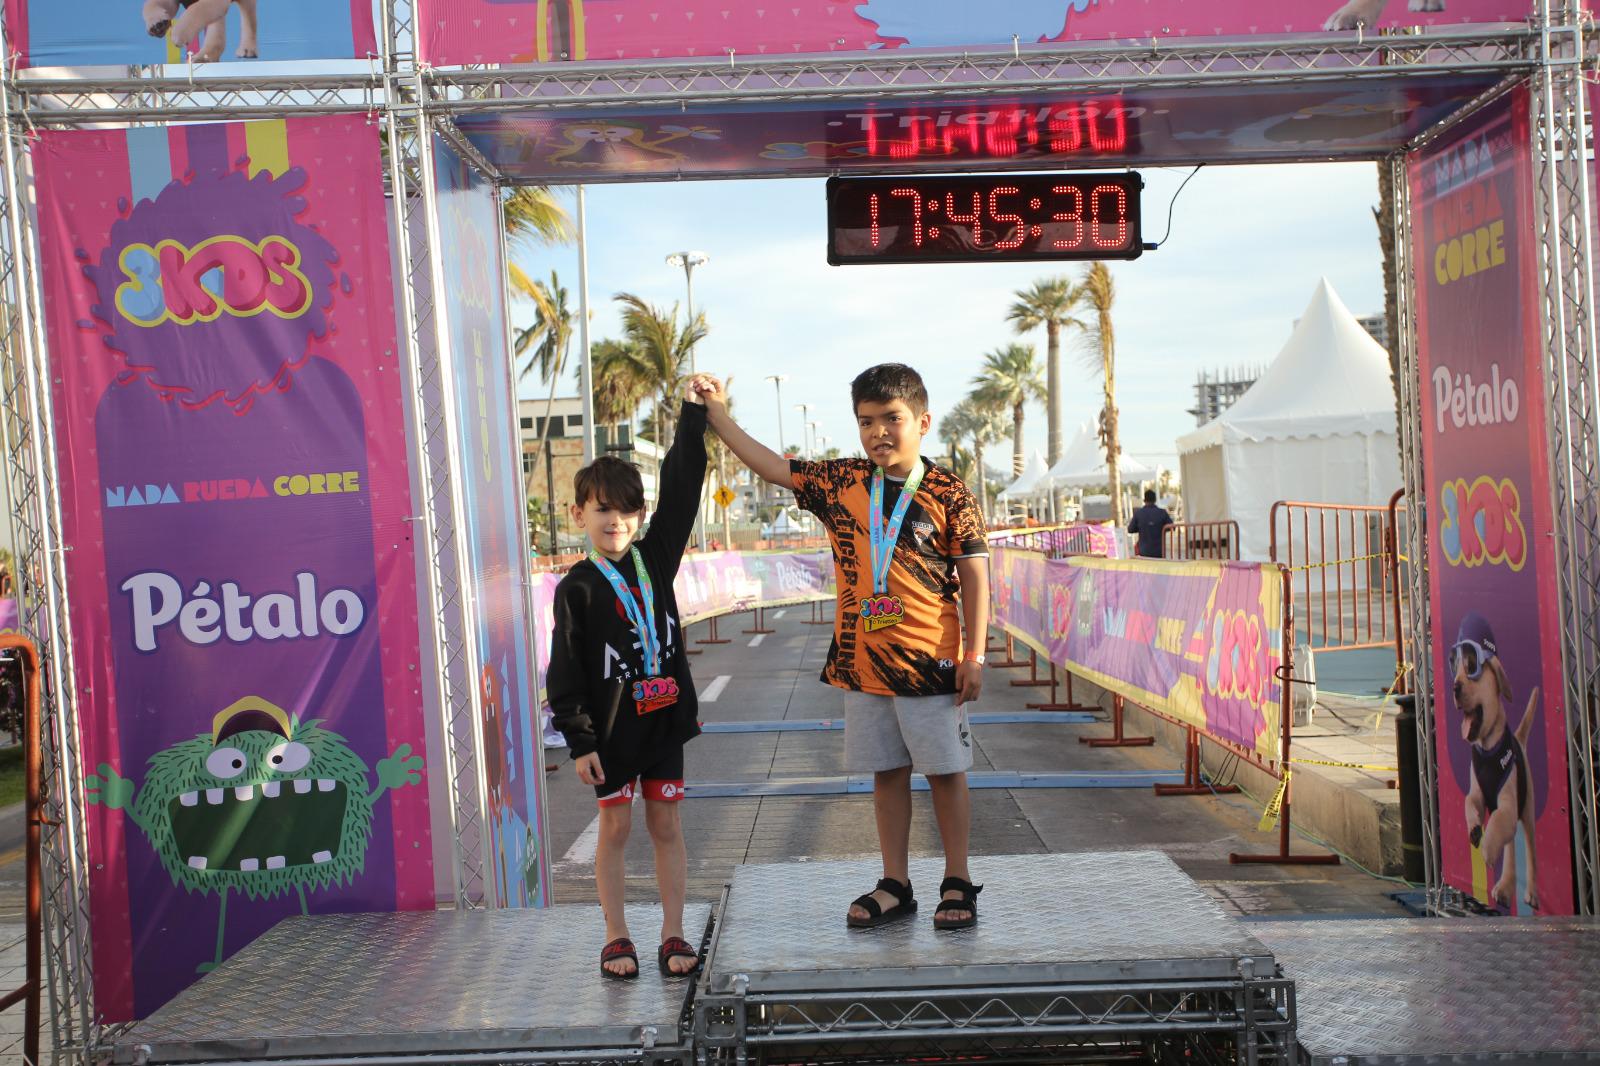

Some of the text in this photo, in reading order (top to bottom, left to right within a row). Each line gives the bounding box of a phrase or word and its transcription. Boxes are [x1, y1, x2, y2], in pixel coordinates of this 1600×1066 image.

[1434, 129, 1496, 198] NADA
[870, 185, 1126, 248] 17:45:30
[1433, 177, 1504, 241] RUEDA
[1434, 220, 1506, 286] CORRE
[1432, 363, 1519, 433] Pétalo
[106, 471, 360, 507] NADA RUEDA CORRE
[121, 572, 364, 651] Pétalo
